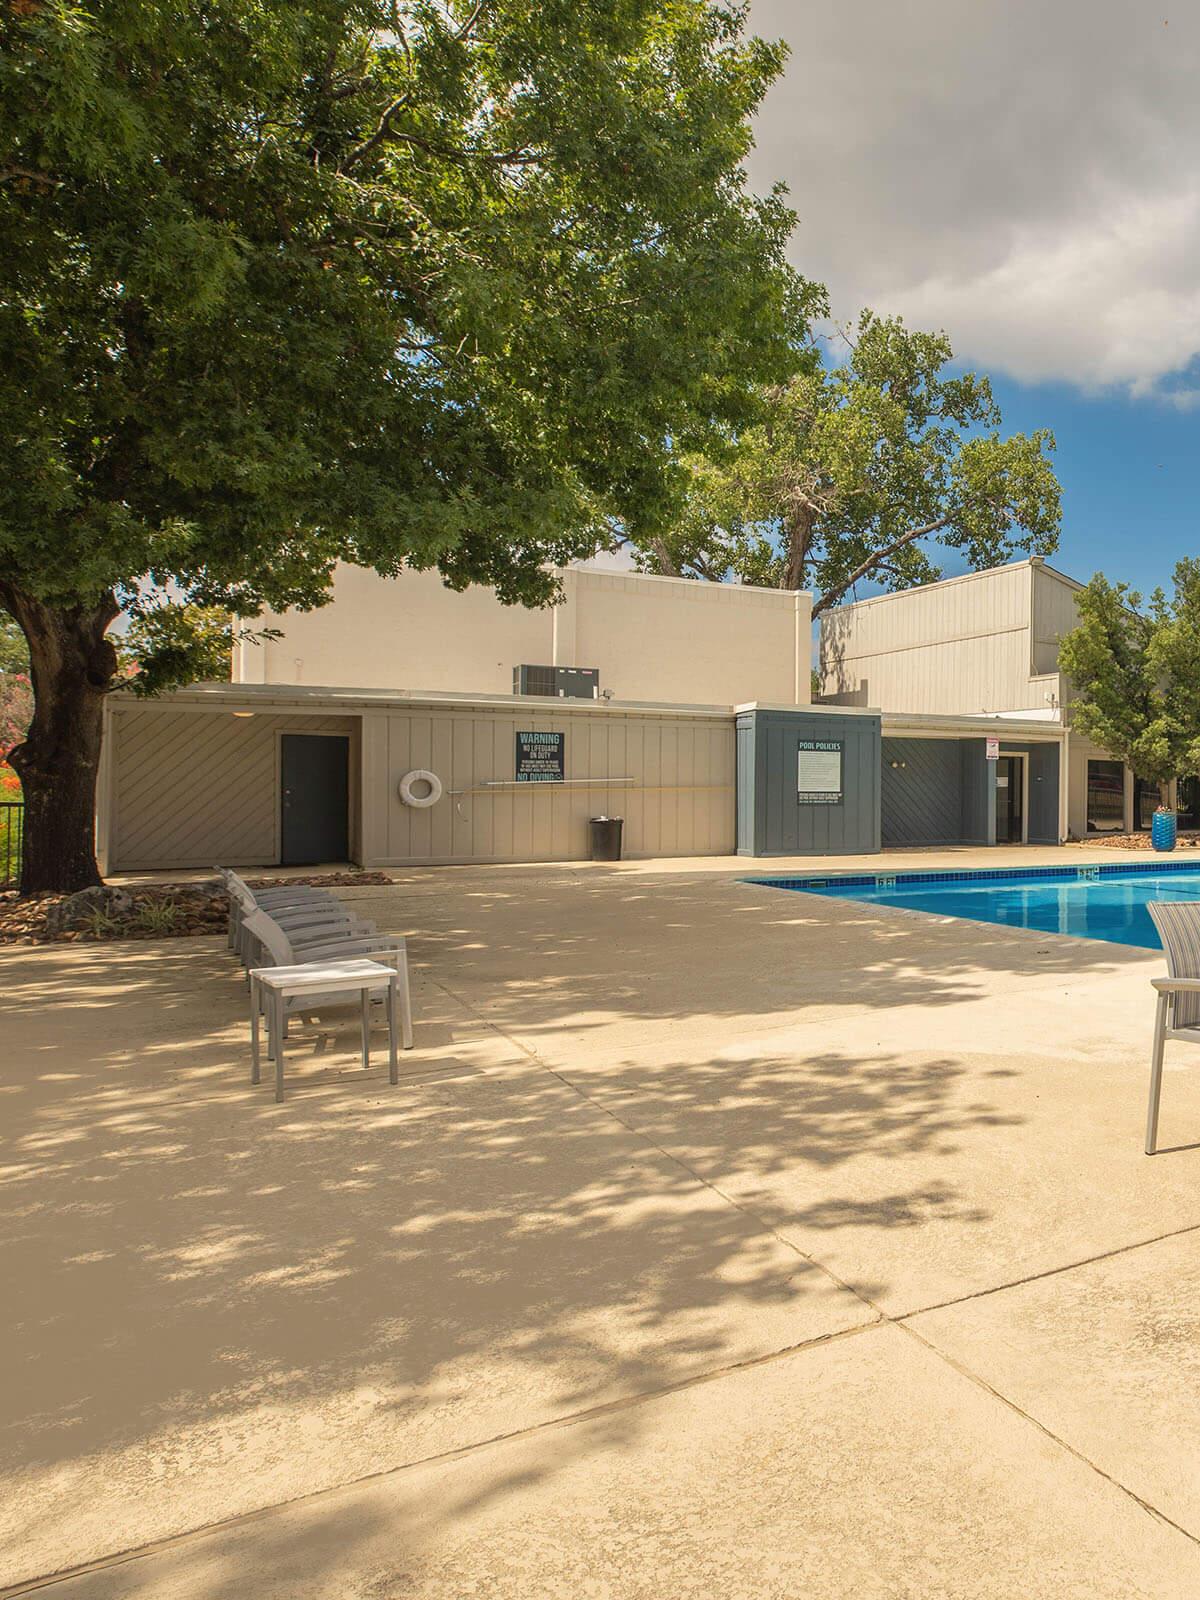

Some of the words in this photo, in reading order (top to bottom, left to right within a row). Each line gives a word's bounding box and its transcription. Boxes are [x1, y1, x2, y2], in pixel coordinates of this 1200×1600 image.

[520, 733, 560, 744] WARNING
[531, 744, 558, 752] LIFEGUARD
[816, 742, 840, 750] POLICIES
[538, 751, 551, 759] DUTY
[518, 772, 528, 781] NO
[530, 772, 554, 781] DIVING
